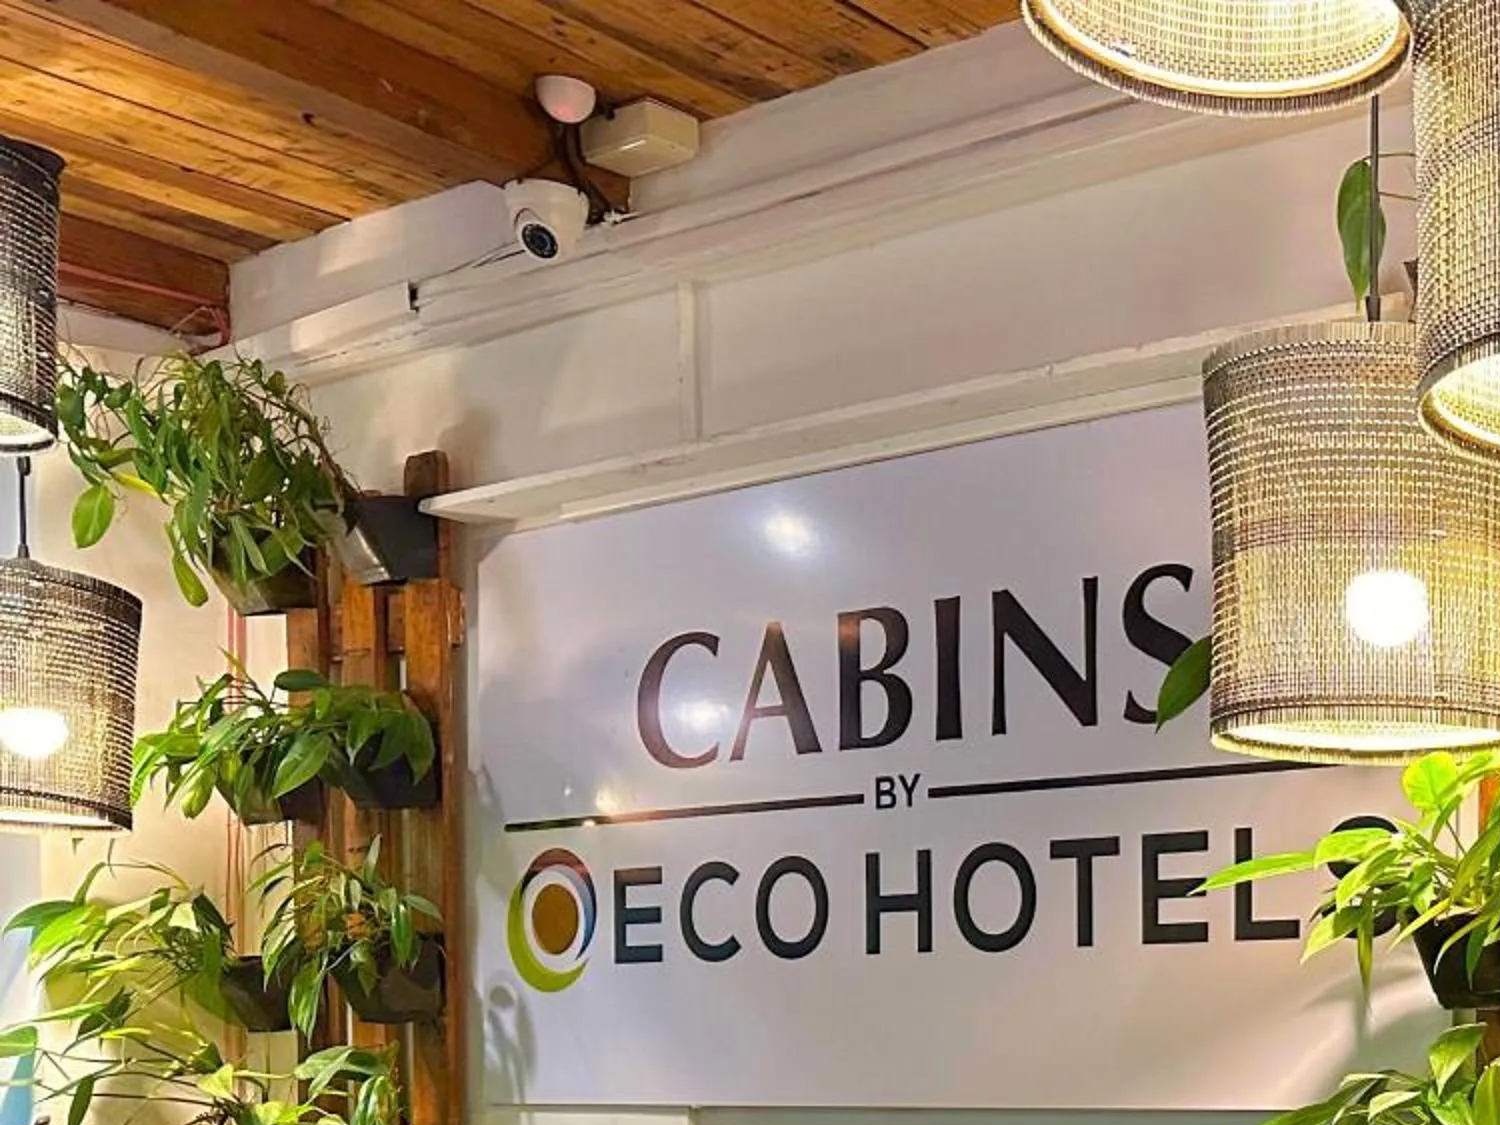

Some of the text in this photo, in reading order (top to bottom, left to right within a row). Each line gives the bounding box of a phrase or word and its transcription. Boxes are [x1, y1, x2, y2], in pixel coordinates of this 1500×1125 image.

[636, 563, 1196, 769] CABINS
[874, 773, 921, 810] BY
[612, 854, 830, 965] ECO
